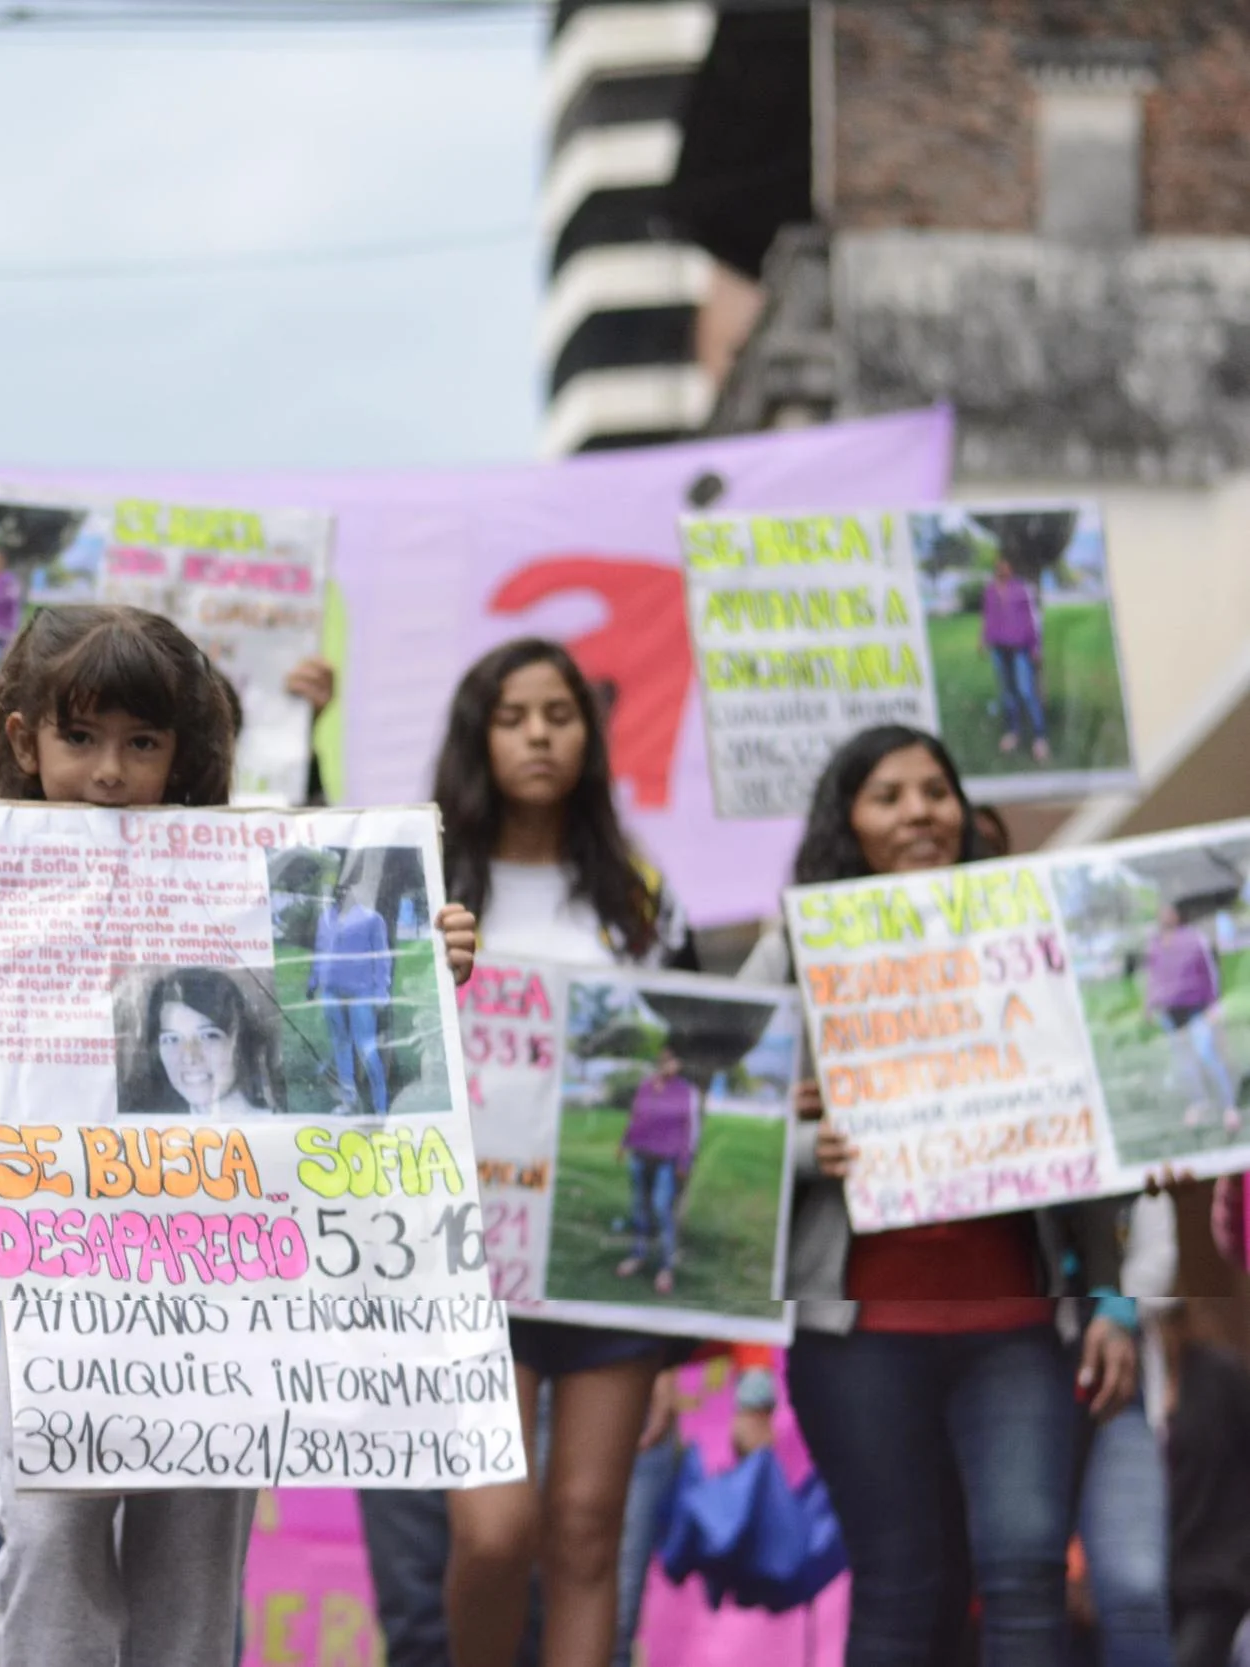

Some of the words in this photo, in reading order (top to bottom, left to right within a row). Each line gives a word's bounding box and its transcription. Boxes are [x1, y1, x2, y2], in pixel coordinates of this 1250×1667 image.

[687, 519, 744, 569] SE
[883, 586, 911, 629] A
[85, 859, 130, 877] Vega
[928, 868, 1052, 937] VEGA
[179, 922, 199, 934] de
[203, 923, 237, 937] pelo
[146, 937, 164, 948] un
[80, 947, 137, 962] llevaba
[142, 951, 171, 963] una
[176, 951, 237, 966] mochila
[70, 993, 91, 1006] de
[12, 1283, 230, 1337] AYUDANOS
[244, 1296, 272, 1332] A
